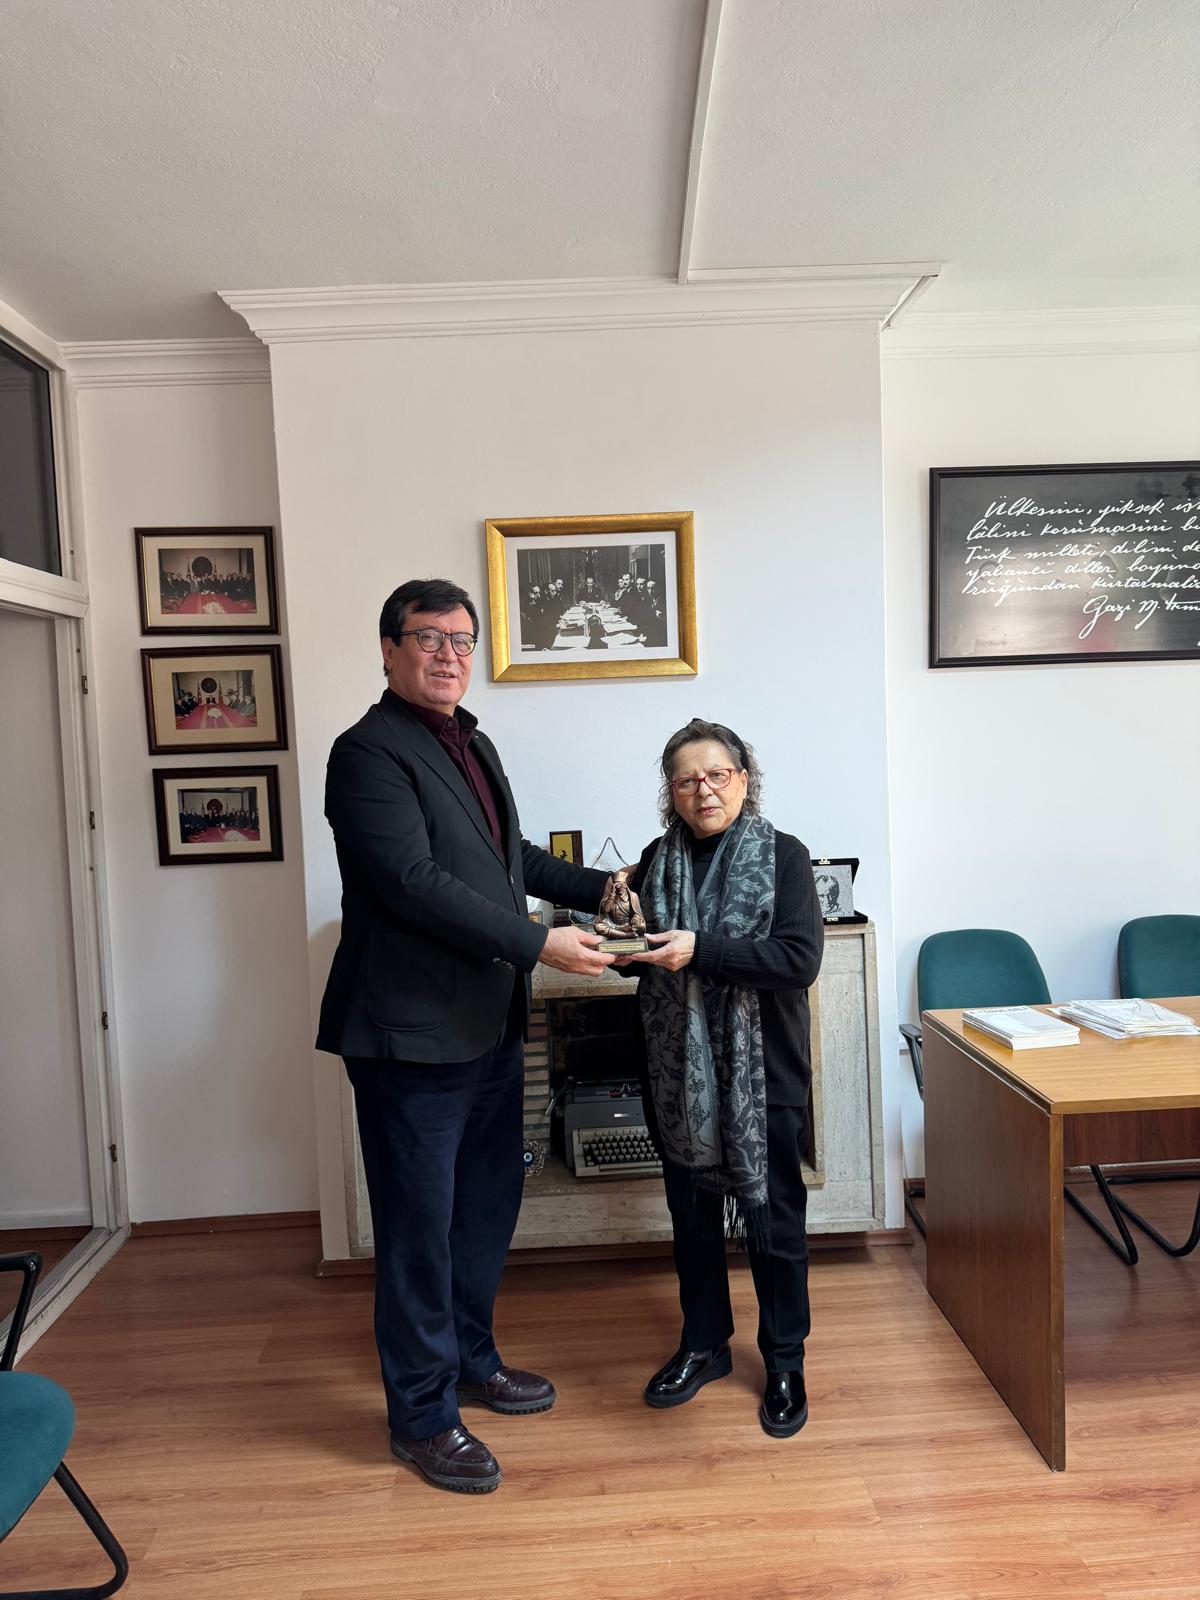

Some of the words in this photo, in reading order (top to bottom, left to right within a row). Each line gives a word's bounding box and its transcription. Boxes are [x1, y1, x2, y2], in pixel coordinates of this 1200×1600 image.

[965, 545, 1016, 565] Türk
[1111, 538, 1177, 554] dilini
[1064, 561, 1116, 574] diller
[1078, 595, 1135, 639] Gazi
